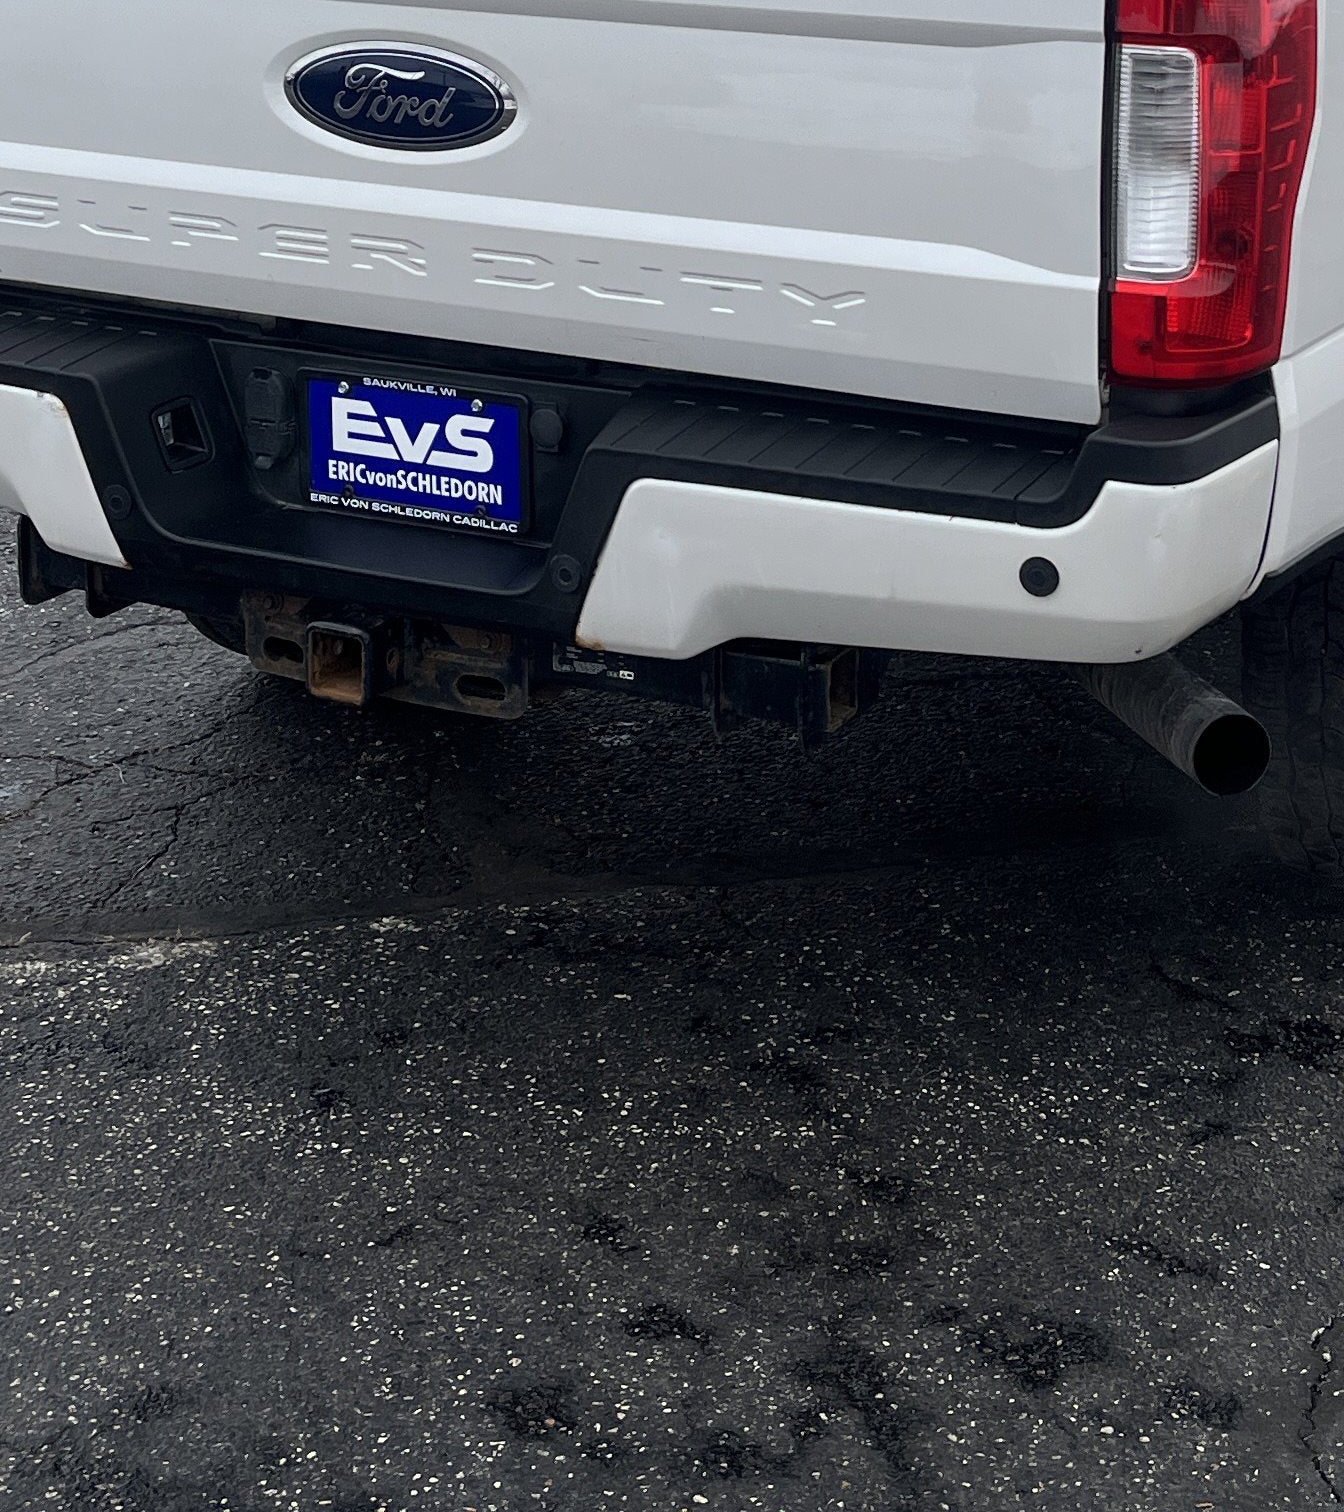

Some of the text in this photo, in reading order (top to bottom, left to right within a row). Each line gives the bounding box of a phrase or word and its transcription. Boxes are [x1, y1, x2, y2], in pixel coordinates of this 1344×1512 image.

[332, 61, 455, 130] Ford
[472, 245, 866, 326] DUTY
[362, 376, 457, 397] SAUKVILLE, WI
[327, 459, 503, 506] ERICvonSCHLEDORN
[309, 492, 518, 533] ERIC VON SCHLEDORN CADILLAC
